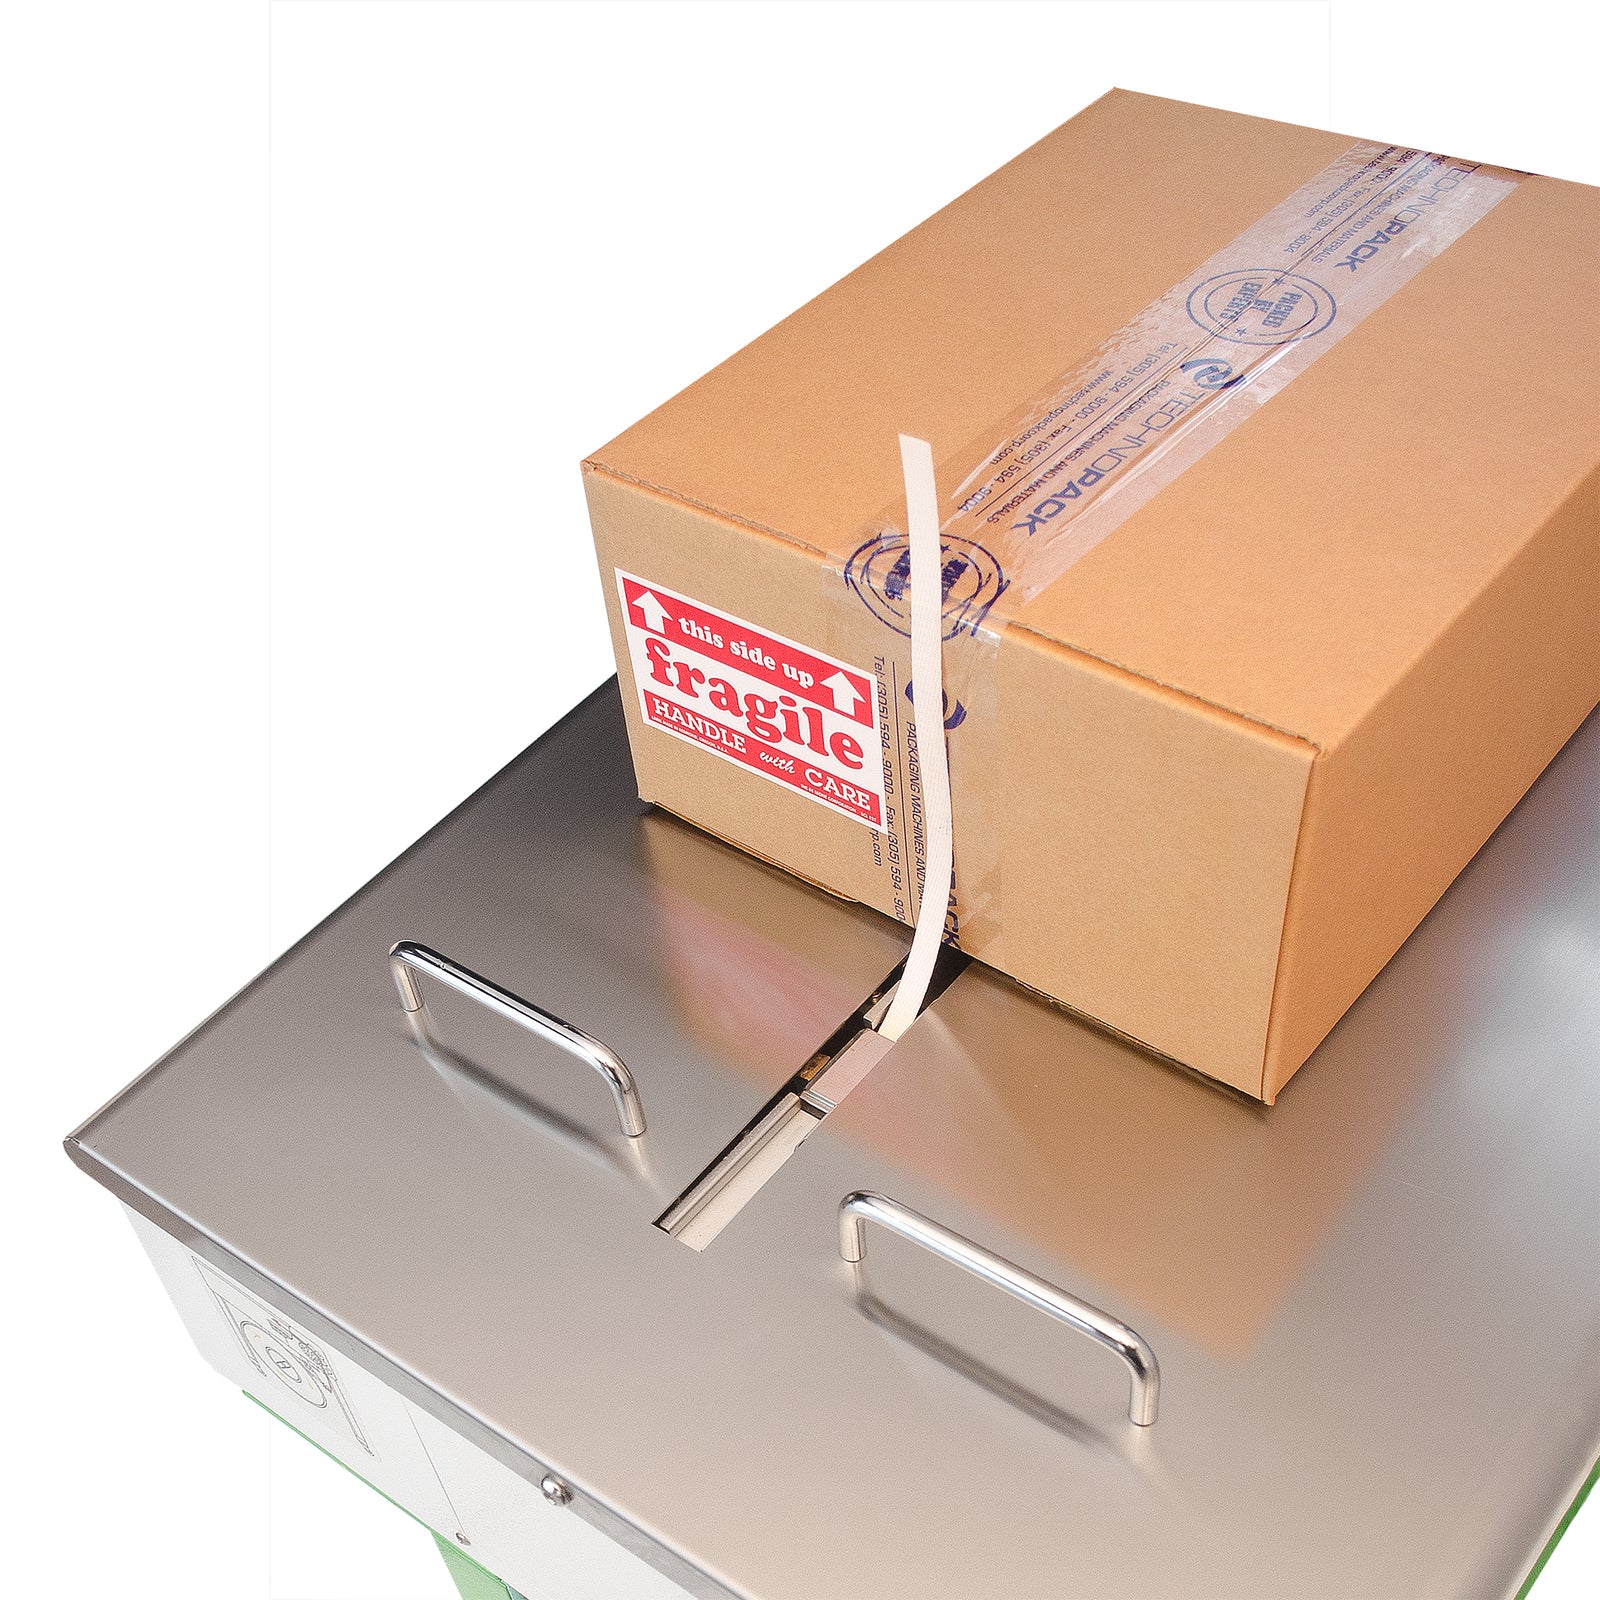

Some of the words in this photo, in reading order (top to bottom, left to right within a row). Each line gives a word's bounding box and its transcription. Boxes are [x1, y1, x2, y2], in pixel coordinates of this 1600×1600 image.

[1335, 163, 1482, 272] TECHNOPACK
[1127, 354, 1160, 376] (305)
[1109, 376, 1133, 392] 594
[1075, 397, 1107, 419] 9000
[1011, 392, 1206, 536] TECHNOPACK
[1014, 440, 1050, 465] (305)
[994, 465, 1021, 483] 594
[987, 479, 1047, 523] MATERIALS
[678, 617, 723, 649] this
[730, 641, 776, 670] side
[782, 662, 814, 689] up
[874, 656, 885, 678] Tel:
[645, 637, 864, 769] fragile
[880, 721, 892, 749] 594
[653, 698, 746, 753] HANDLE
[759, 750, 795, 775] with
[805, 768, 870, 811] CARE
[906, 721, 920, 793] PACKAGING
[911, 794, 926, 856] MACHINES
[887, 830, 900, 865] (305)
[891, 866, 902, 891] 594
[916, 856, 926, 882] AND
